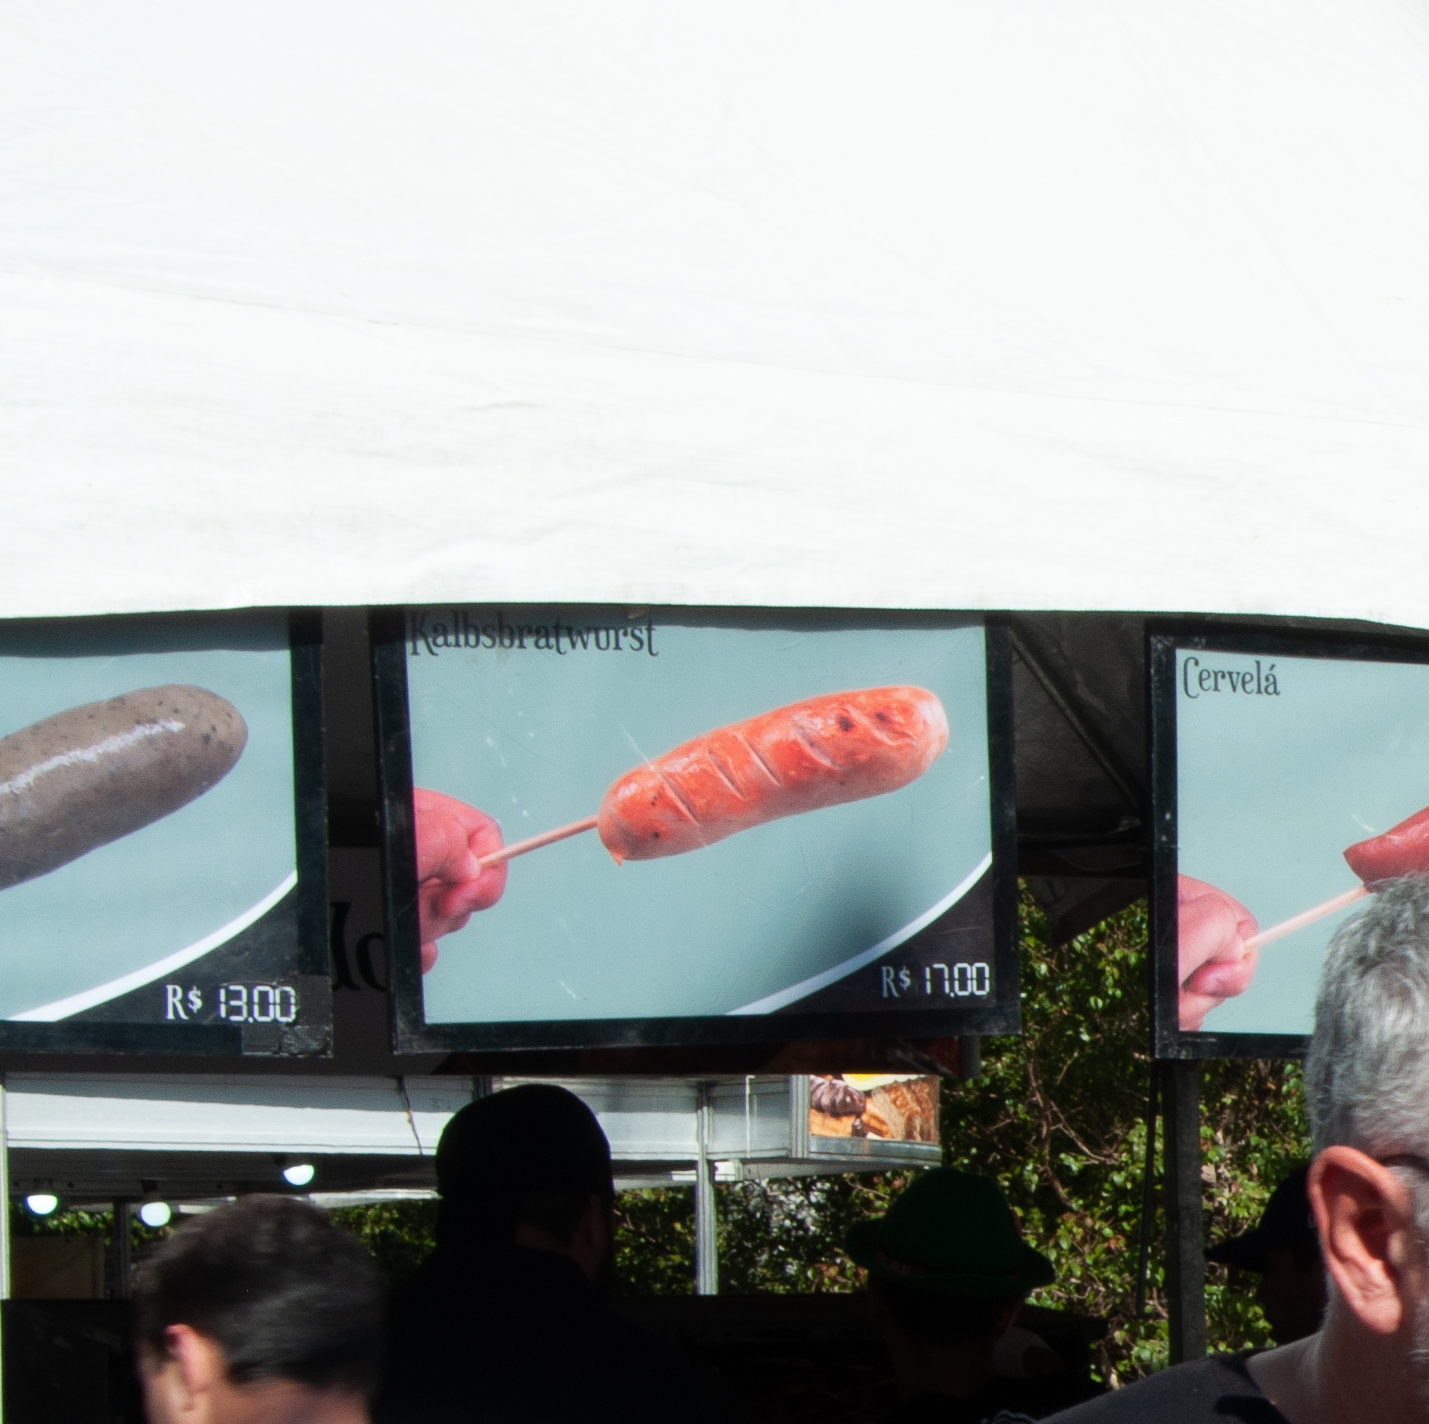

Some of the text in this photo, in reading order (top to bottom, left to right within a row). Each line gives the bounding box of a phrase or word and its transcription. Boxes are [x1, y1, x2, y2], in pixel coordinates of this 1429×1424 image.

[408, 609, 659, 657] Kalbsbratwurst
[1183, 656, 1281, 699] Cervelá
[881, 962, 991, 998] R$ 17.00
[166, 985, 297, 1024] R$ 13.00
